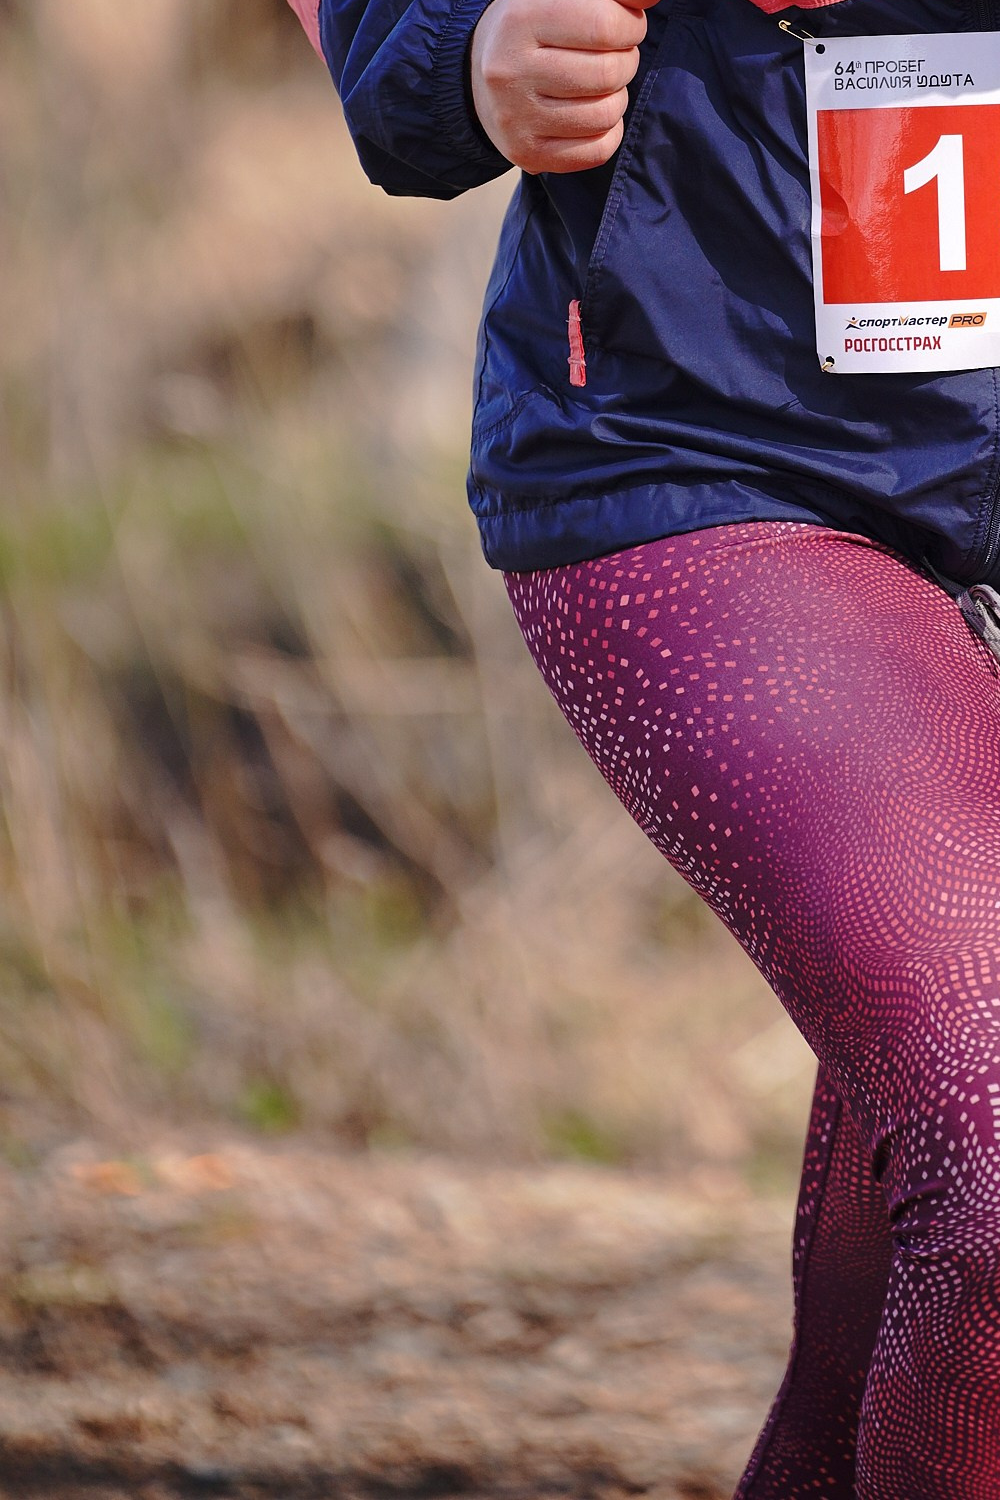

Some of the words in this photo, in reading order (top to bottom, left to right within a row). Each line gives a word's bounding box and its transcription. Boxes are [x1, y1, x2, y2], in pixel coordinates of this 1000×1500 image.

[865, 59, 926, 73] ПРОБЕГ
[834, 75, 912, 90] ВАСИЛИЯ
[951, 314, 984, 326] PRO
[844, 336, 942, 353] РОСГОССТРАХ
